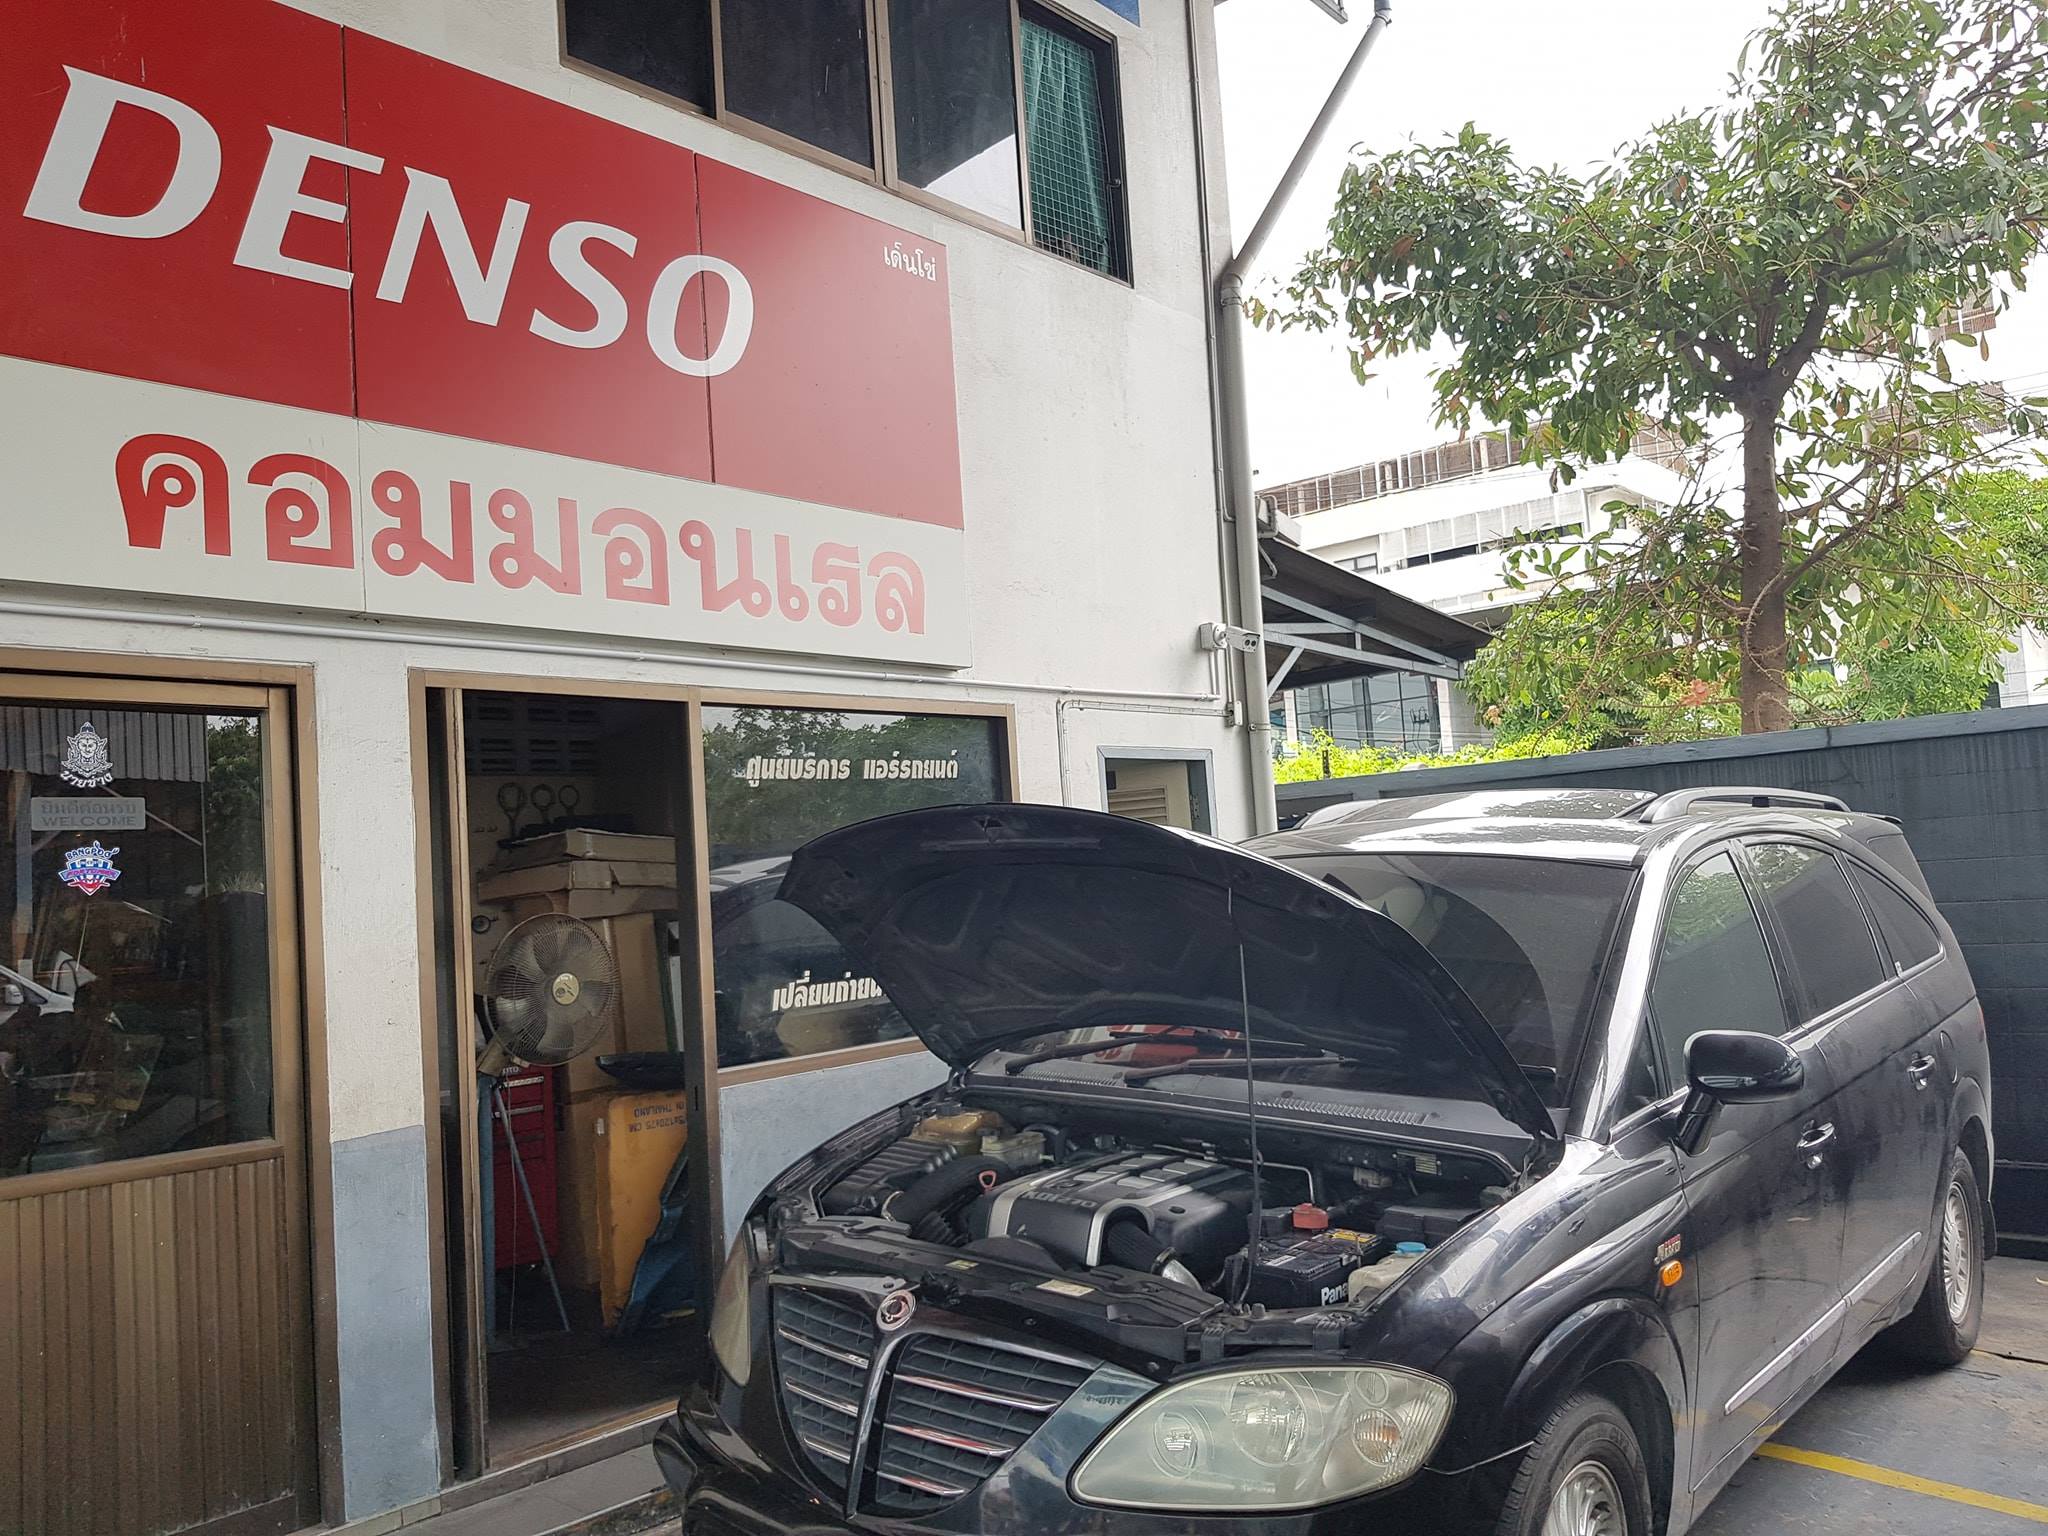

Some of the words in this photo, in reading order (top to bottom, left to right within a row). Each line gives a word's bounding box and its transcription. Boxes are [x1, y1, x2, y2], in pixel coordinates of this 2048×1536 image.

[23, 64, 755, 378] DENSO
[115, 433, 926, 635] คอมมอนเรล
[745, 750, 851, 788] ศูนย์บริการ
[863, 749, 959, 780] แอร์รถยนต์
[41, 816, 136, 827] WELCOME
[772, 970, 883, 1012] เปลี่ยนถ่ายน
[1320, 1282, 1349, 1306] Pana
